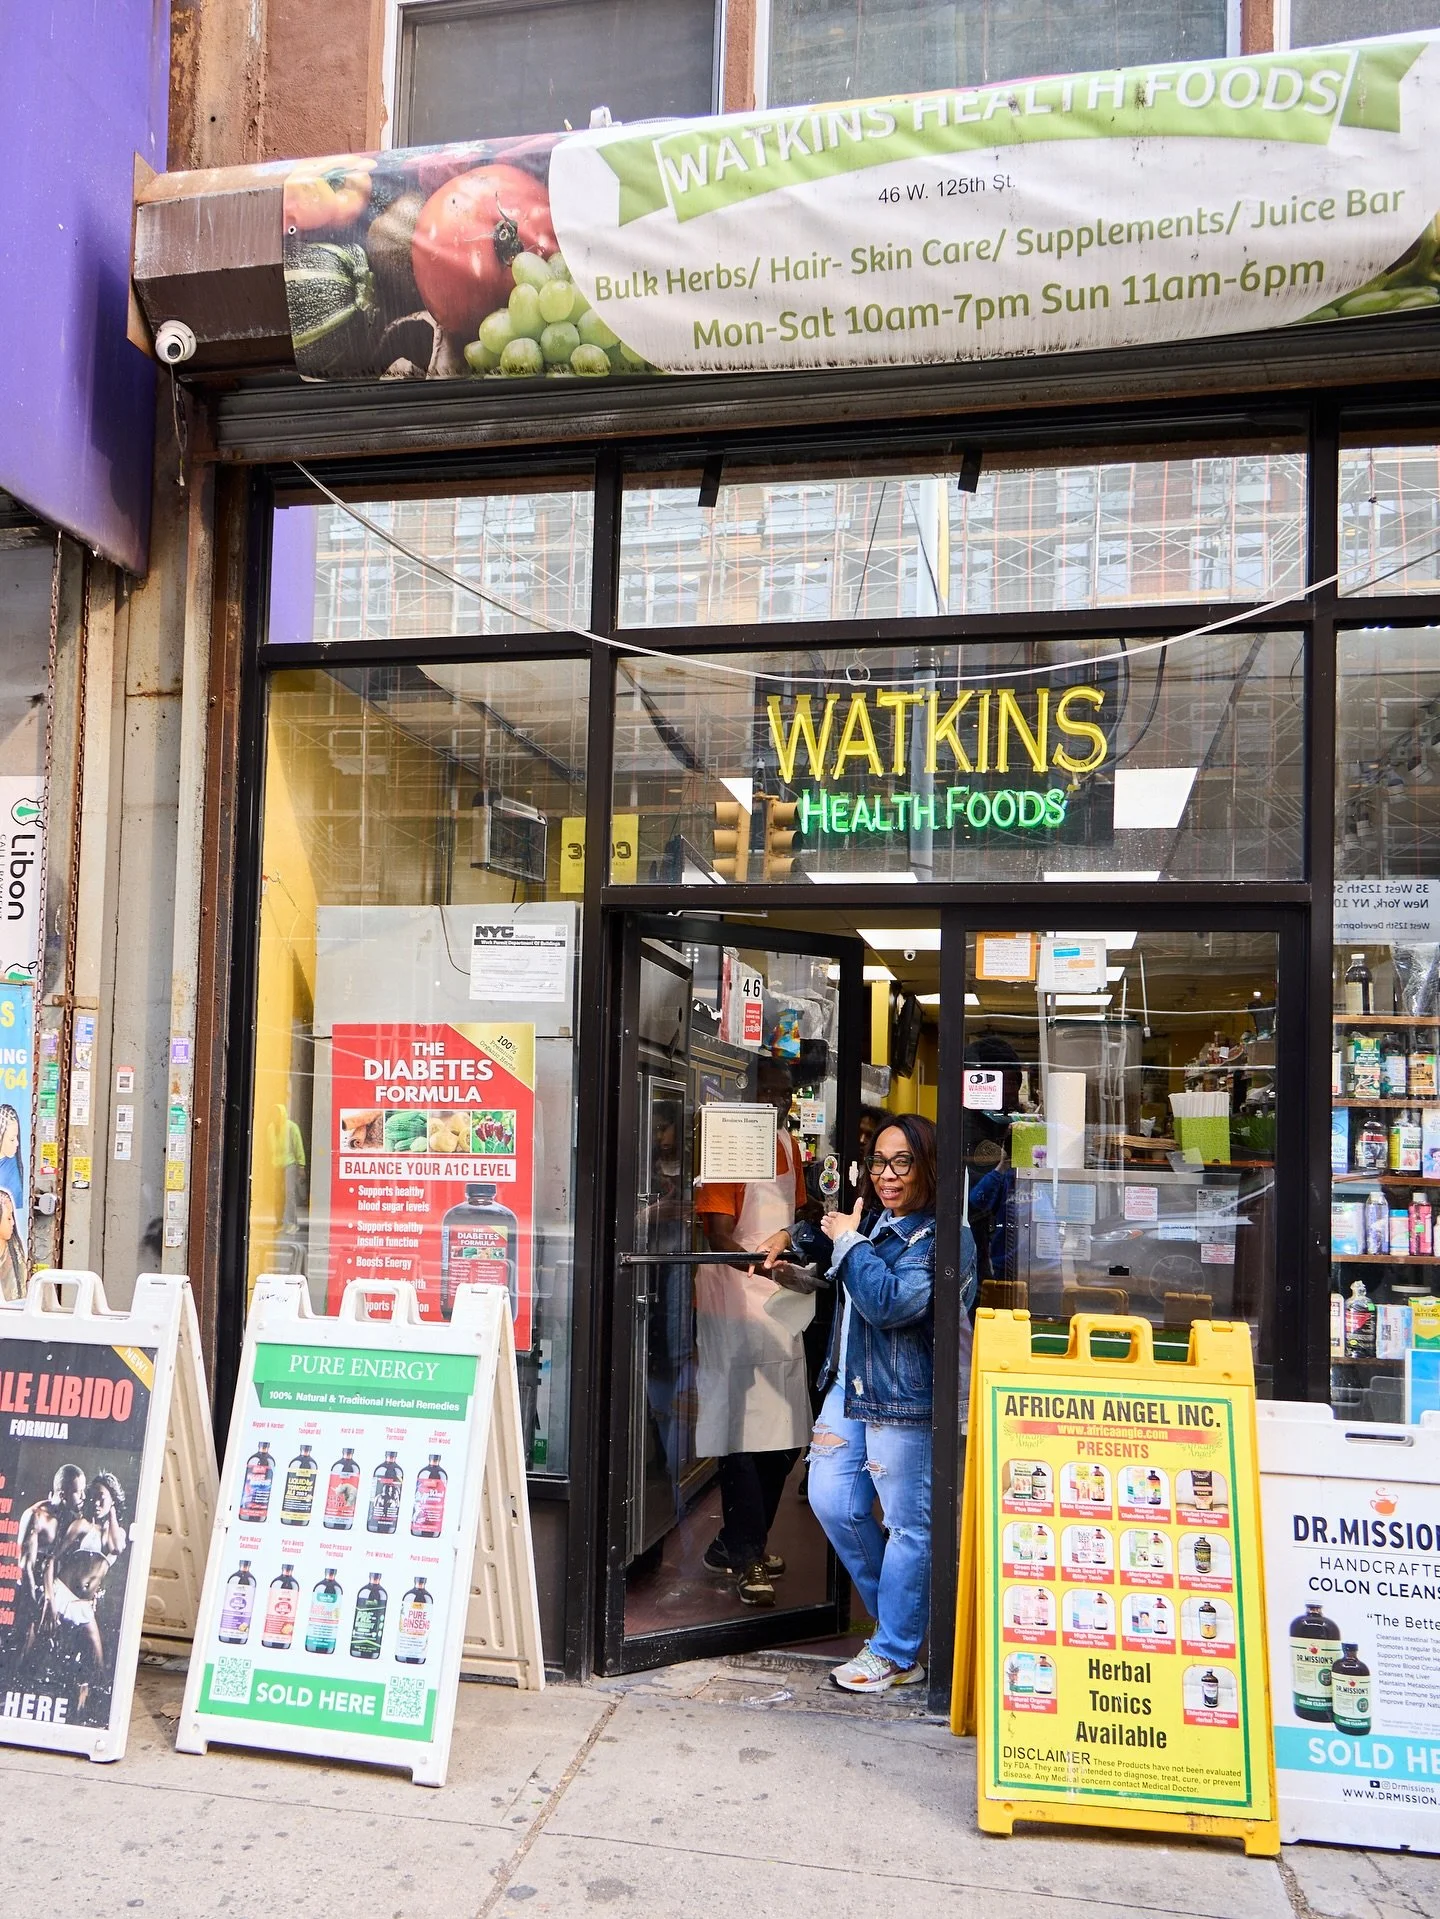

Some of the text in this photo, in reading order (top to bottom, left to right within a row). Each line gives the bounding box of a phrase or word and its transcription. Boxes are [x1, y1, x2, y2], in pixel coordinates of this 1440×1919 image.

[664, 66, 1343, 193] WATKINS HEALTH FOODS
[879, 174, 1016, 204] 46 W. 125th St.
[596, 188, 1405, 301] Bulk Herbs/ Hair- Skin Care/ Supplements/ Juice Bar
[694, 258, 1324, 350] Mon-Sat 10am-7pm Sun 11am-6pm
[766, 686, 1107, 784] WATKINS
[800, 785, 1068, 835] HEALTH FOODS
[8, 835, 35, 920] Libon
[476, 926, 514, 937] NYC
[743, 979, 760, 997] 46
[412, 1042, 445, 1056] THE
[364, 1059, 495, 1081] DIABETES
[375, 1086, 483, 1103] FORMULA
[344, 1161, 512, 1177] BALANCE YOUR A1C LEVEL
[358, 1185, 424, 1198] Supports healthy
[358, 1200, 430, 1213] blood sugar levels
[357, 1220, 424, 1234] Supports healthy
[357, 1236, 419, 1247] insulin function
[356, 1256, 412, 1270] Boosts Energy
[124, 1347, 149, 1375] NEW!
[288, 1355, 440, 1381] PURE ENERGY
[0, 1371, 134, 1422] LE LIBIDO
[269, 1391, 460, 1412] 100% Natural & Traditional Herbal Remedies
[1005, 1395, 1221, 1427] AFRICAN ANGEL INC.
[10, 1418, 69, 1440] FORMULA
[1077, 1441, 1149, 1459] PRESENTS
[1293, 1514, 1440, 1551] DR.MISSIO
[1309, 1577, 1440, 1600] COLON CLEAN
[404, 1619, 430, 1630] GINSENG
[409, 1611, 427, 1619] PURE
[1089, 1658, 1151, 1684] Herbal
[4, 1691, 68, 1723] HERE
[255, 1682, 376, 1715] SOLD HERE
[1089, 1689, 1152, 1715] Tonics
[1405, 1700, 1425, 1708] Energy
[1076, 1721, 1167, 1749] Available
[1003, 1746, 1090, 1765] DISCLAIMER
[1094, 1758, 1115, 1767] These
[1117, 1761, 1150, 1770] Products
[1186, 1766, 1204, 1774] been
[1206, 1769, 1241, 1777] evaluated
[1309, 1737, 1394, 1770] SOLD
[1004, 1761, 1012, 1769] by
[1034, 1763, 1051, 1772] They
[1124, 1771, 1159, 1780] diagnose,
[1161, 1774, 1180, 1782] treat,
[1213, 1779, 1241, 1787] prevent
[1004, 1771, 1033, 1780] disease.
[1035, 1773, 1050, 1782] Any
[1081, 1777, 1110, 1785] concern
[1113, 1780, 1140, 1788] contact
[1142, 1782, 1170, 1791] Medical
[1172, 1784, 1199, 1793] Doctor.
[1392, 1783, 1434, 1793] Drmissions
